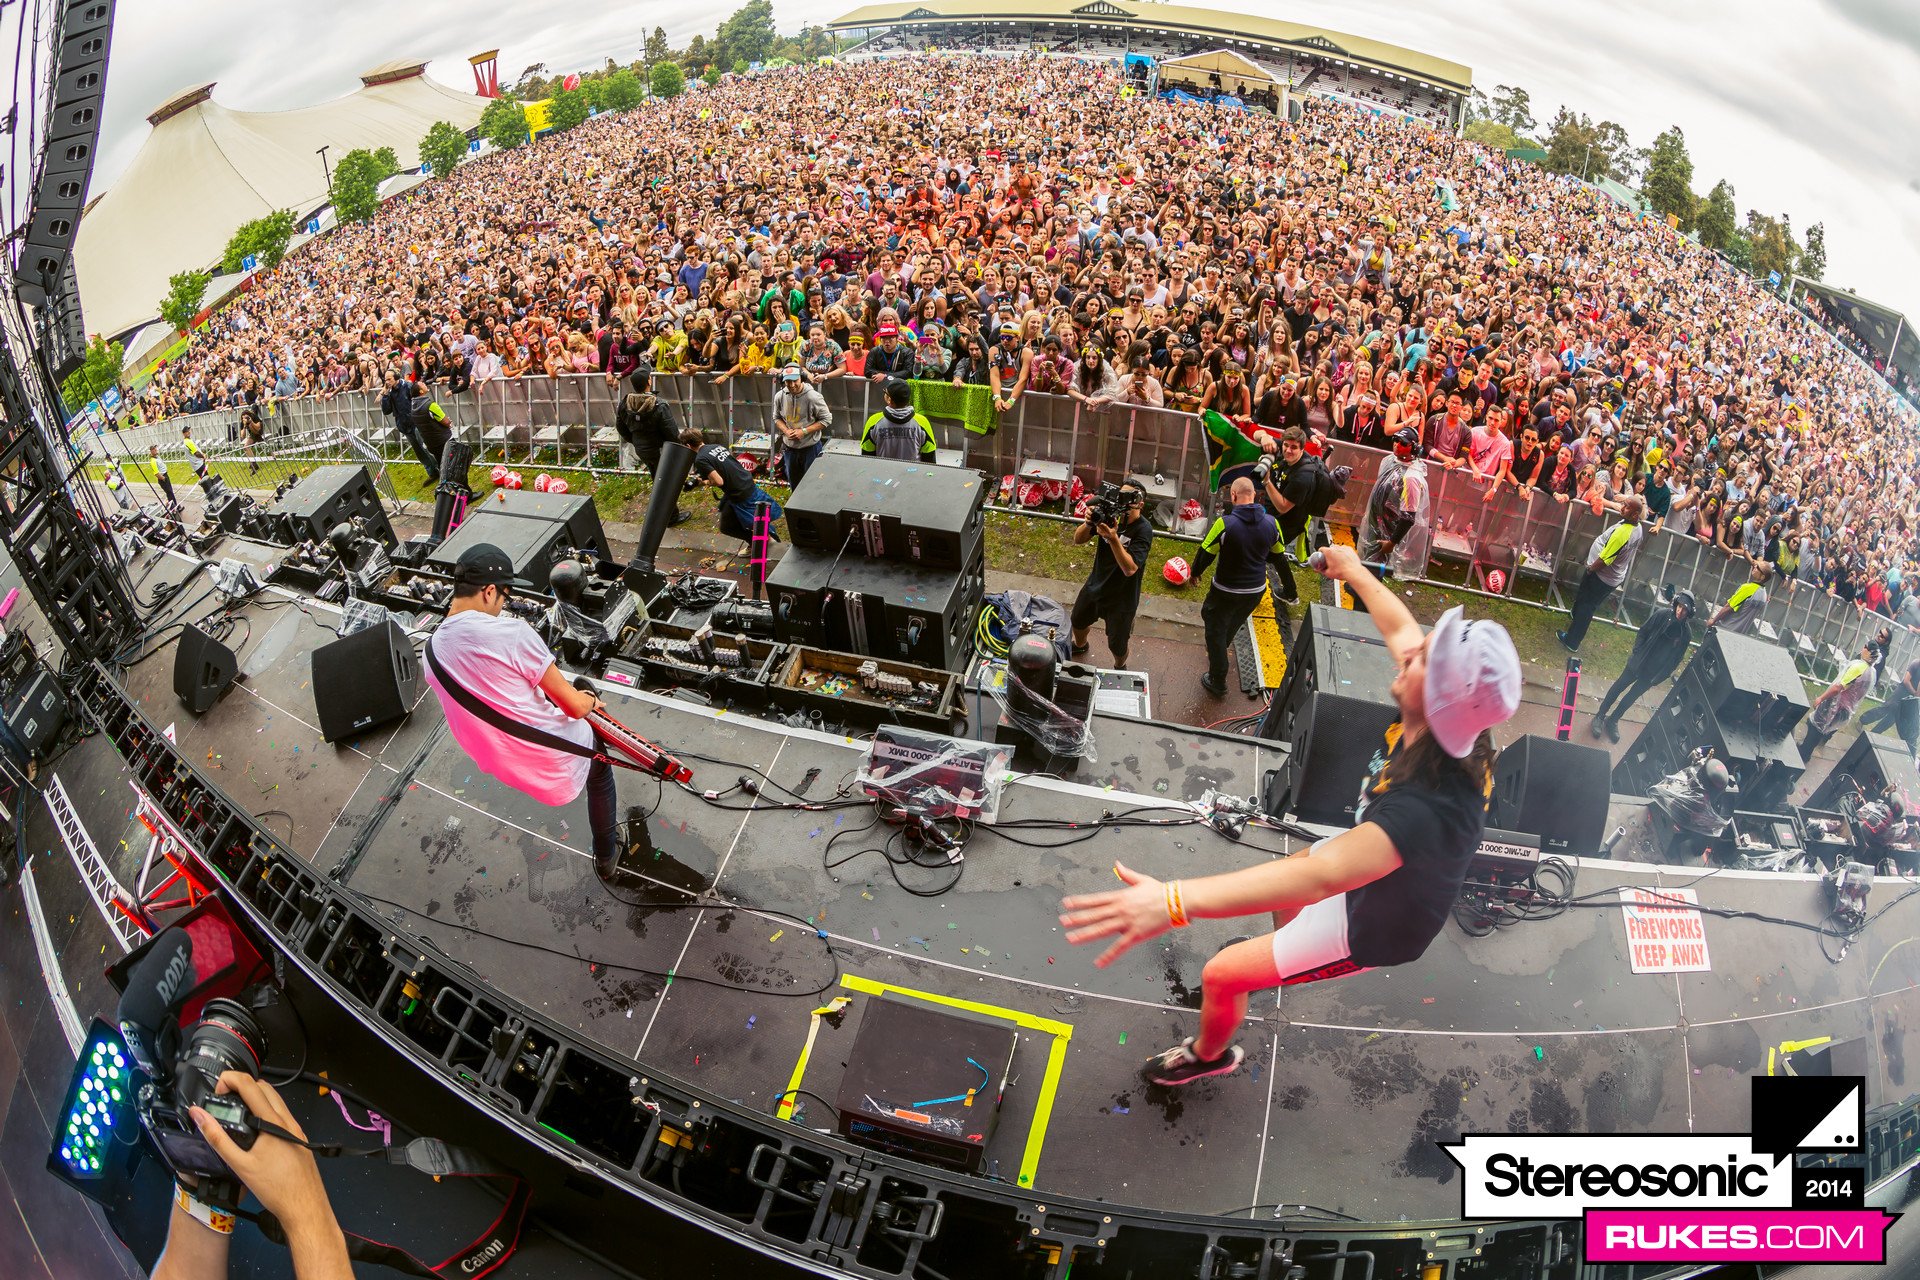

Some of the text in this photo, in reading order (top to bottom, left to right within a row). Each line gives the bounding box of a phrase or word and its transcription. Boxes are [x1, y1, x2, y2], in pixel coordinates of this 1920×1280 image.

[887, 747, 909, 758] DMX
[911, 751, 933, 761] 3000
[1485, 844, 1503, 853] 3000
[1628, 917, 1702, 940] FIREWORKS
[1634, 943, 1705, 967] KEEP AWAY
[461, 1239, 505, 1273] Canon
